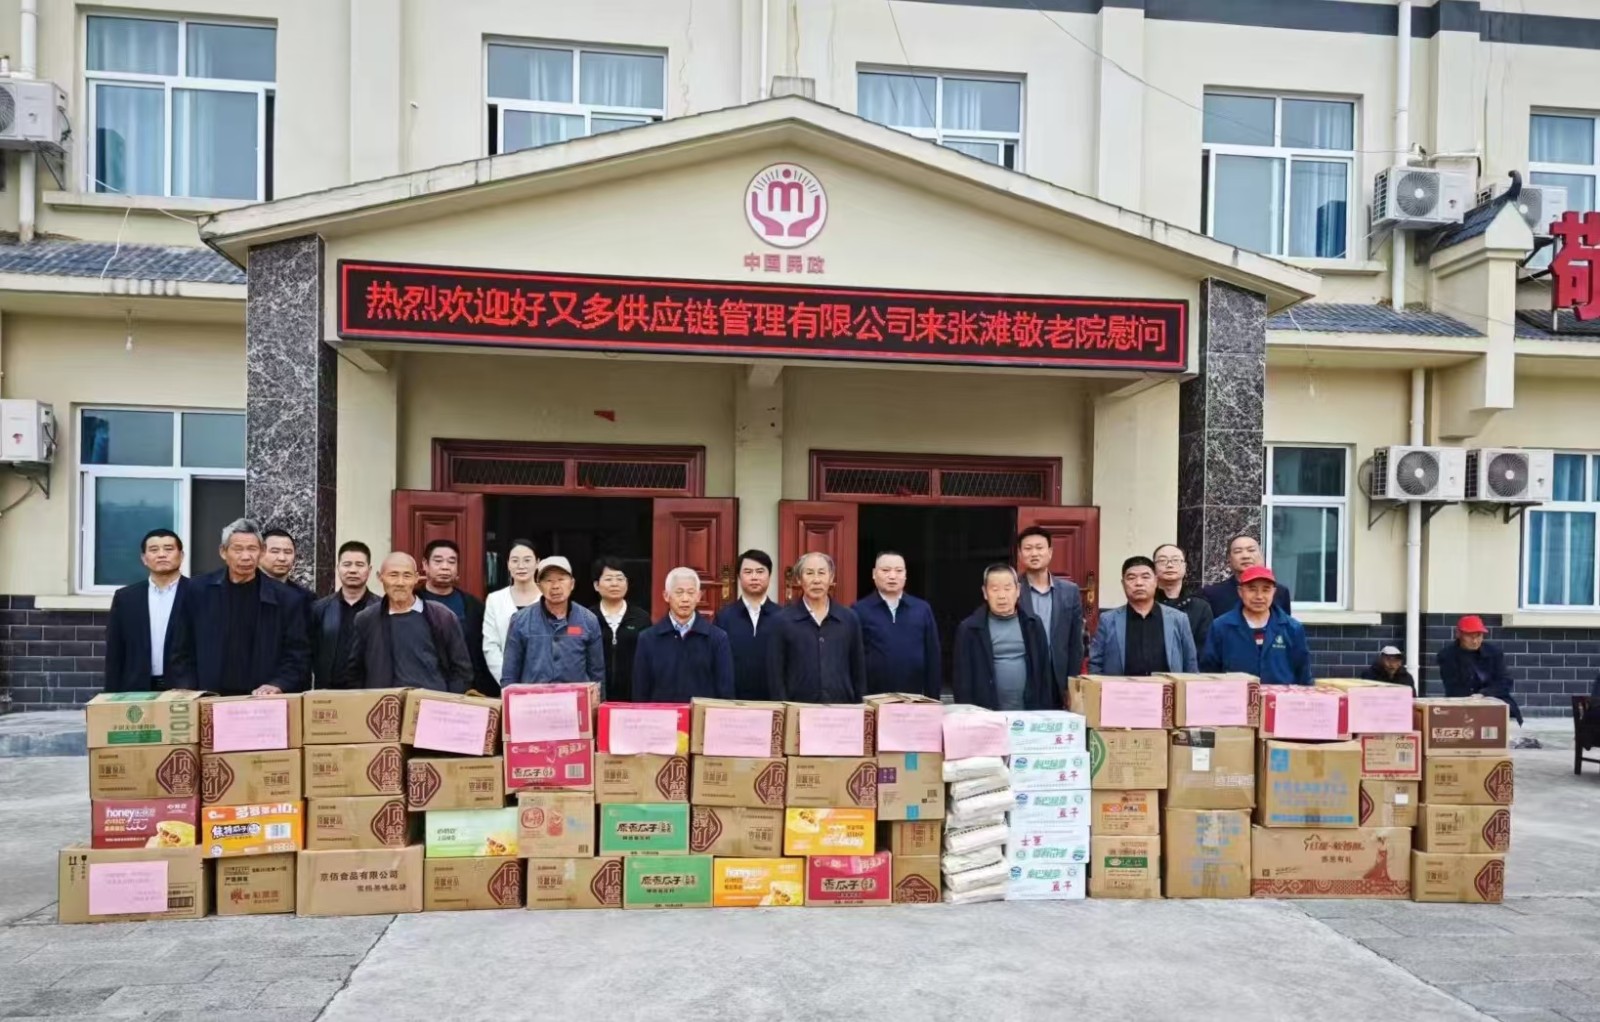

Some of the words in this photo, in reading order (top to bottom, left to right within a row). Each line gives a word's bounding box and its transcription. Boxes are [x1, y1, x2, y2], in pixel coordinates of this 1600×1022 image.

[743, 252, 826, 275] 中国民政
[365, 279, 1168, 354] 热烈欢迎好又多供应链管理有限公司来张滩敬老院慰问
[1055, 734, 1075, 745] 豆干
[1056, 770, 1078, 782] 豆干
[1057, 807, 1079, 819] 豆干
[617, 823, 659, 833] 原香瓜子
[641, 876, 682, 886] 原香瓜子
[1050, 881, 1073, 892] 豆干
